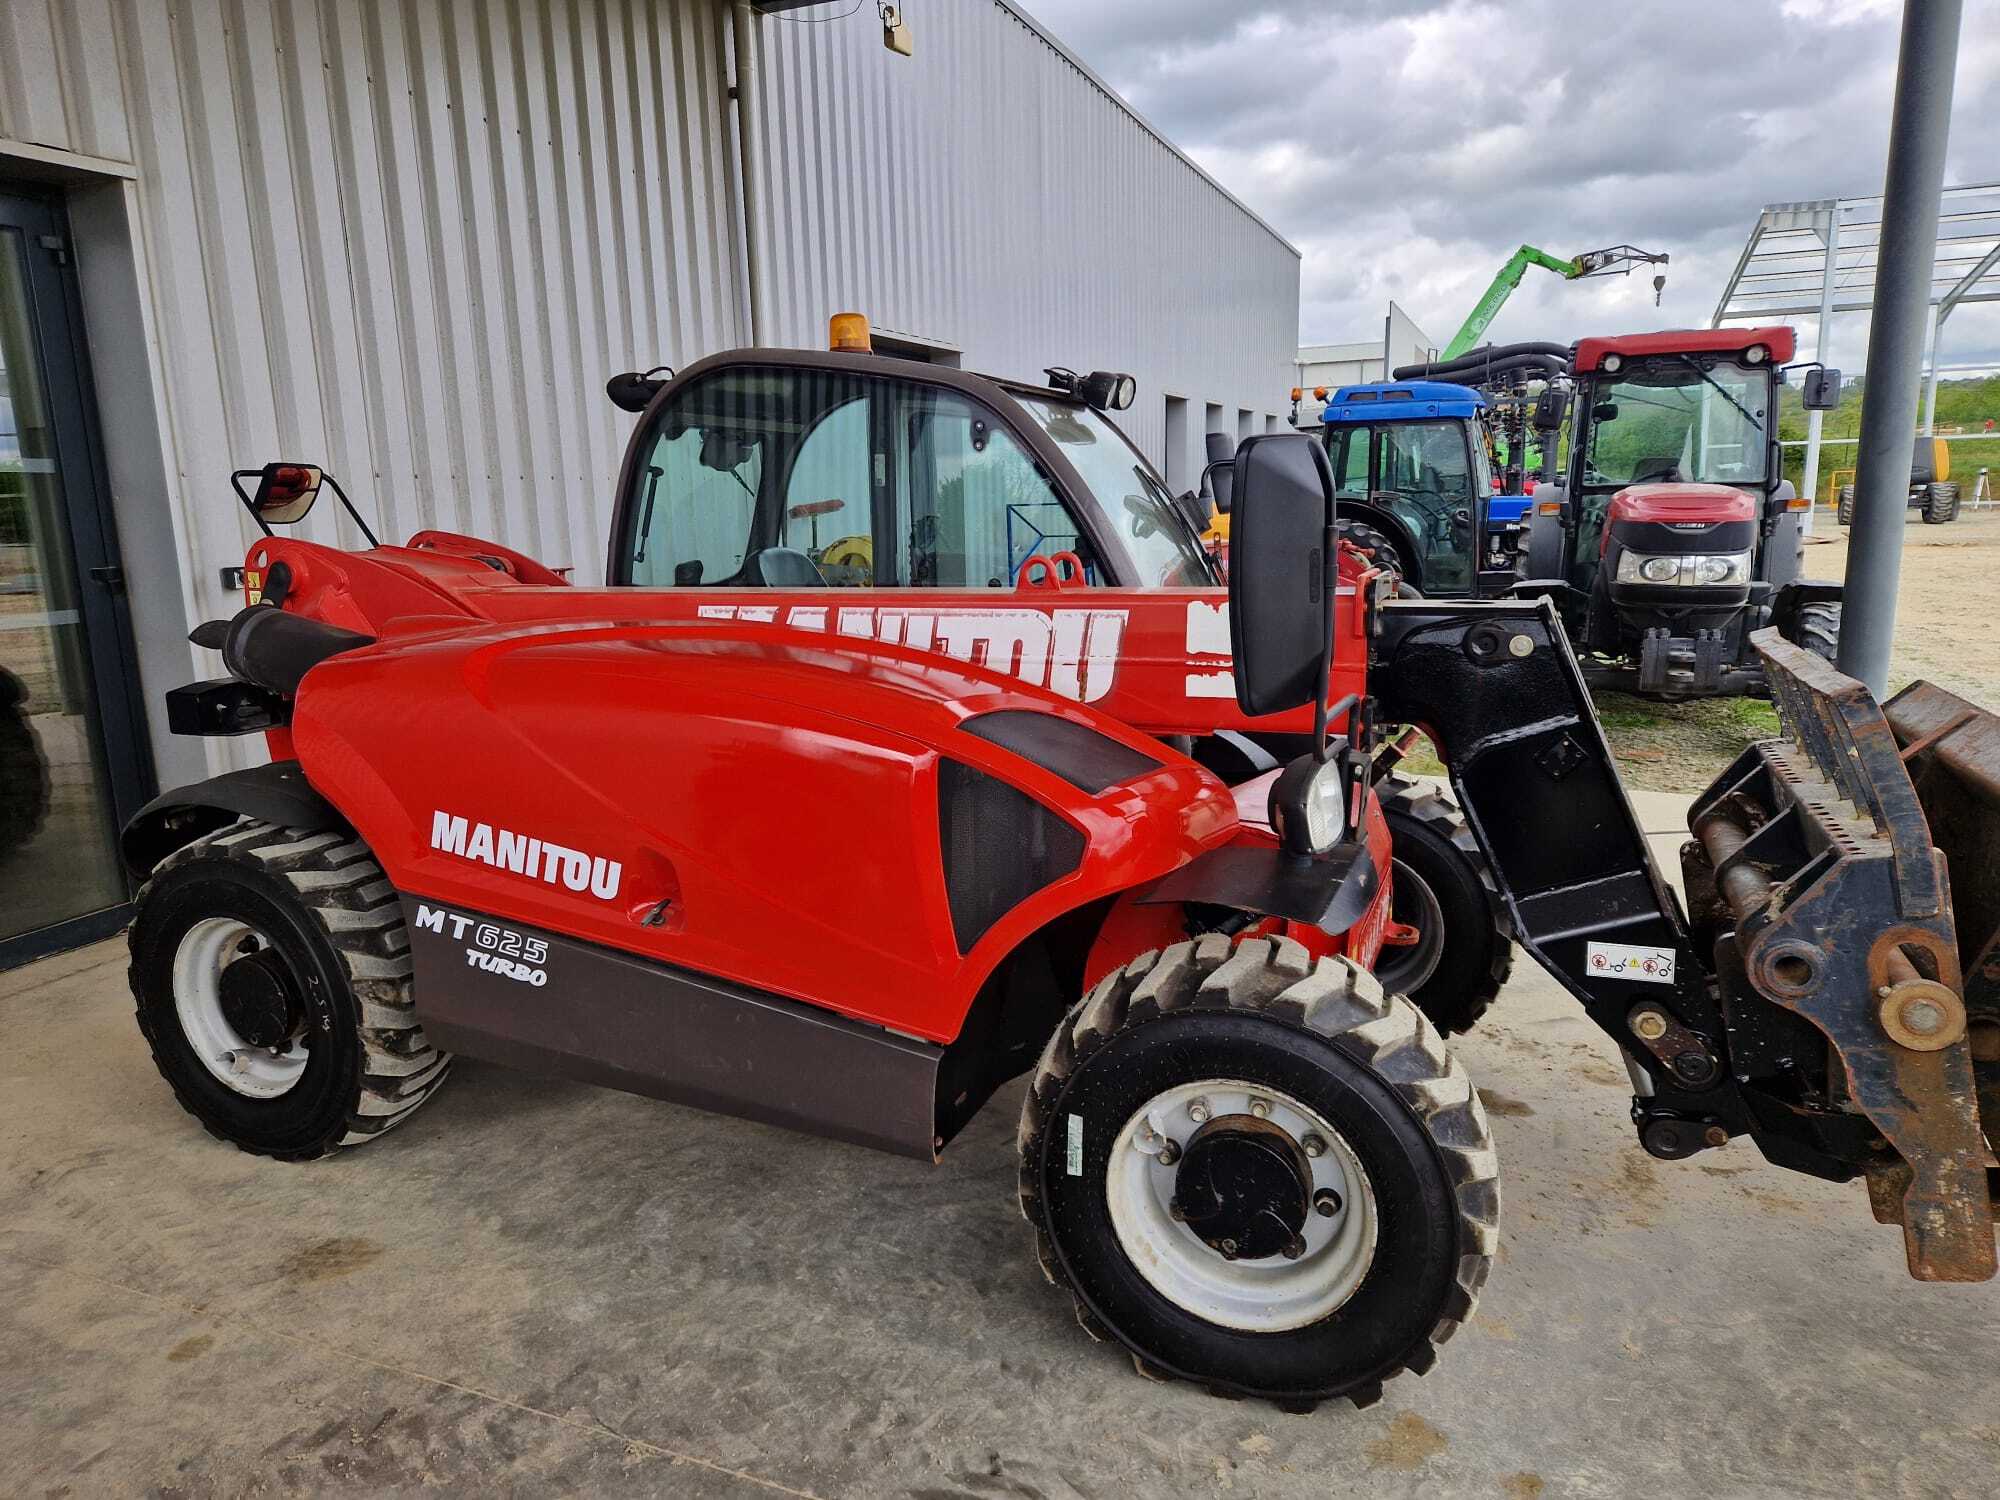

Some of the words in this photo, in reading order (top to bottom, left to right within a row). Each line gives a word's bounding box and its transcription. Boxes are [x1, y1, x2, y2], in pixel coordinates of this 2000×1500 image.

[431, 809, 622, 900] MANITOU
[415, 904, 474, 940] MT
[475, 923, 549, 965] 625
[466, 948, 548, 987] TURBO
